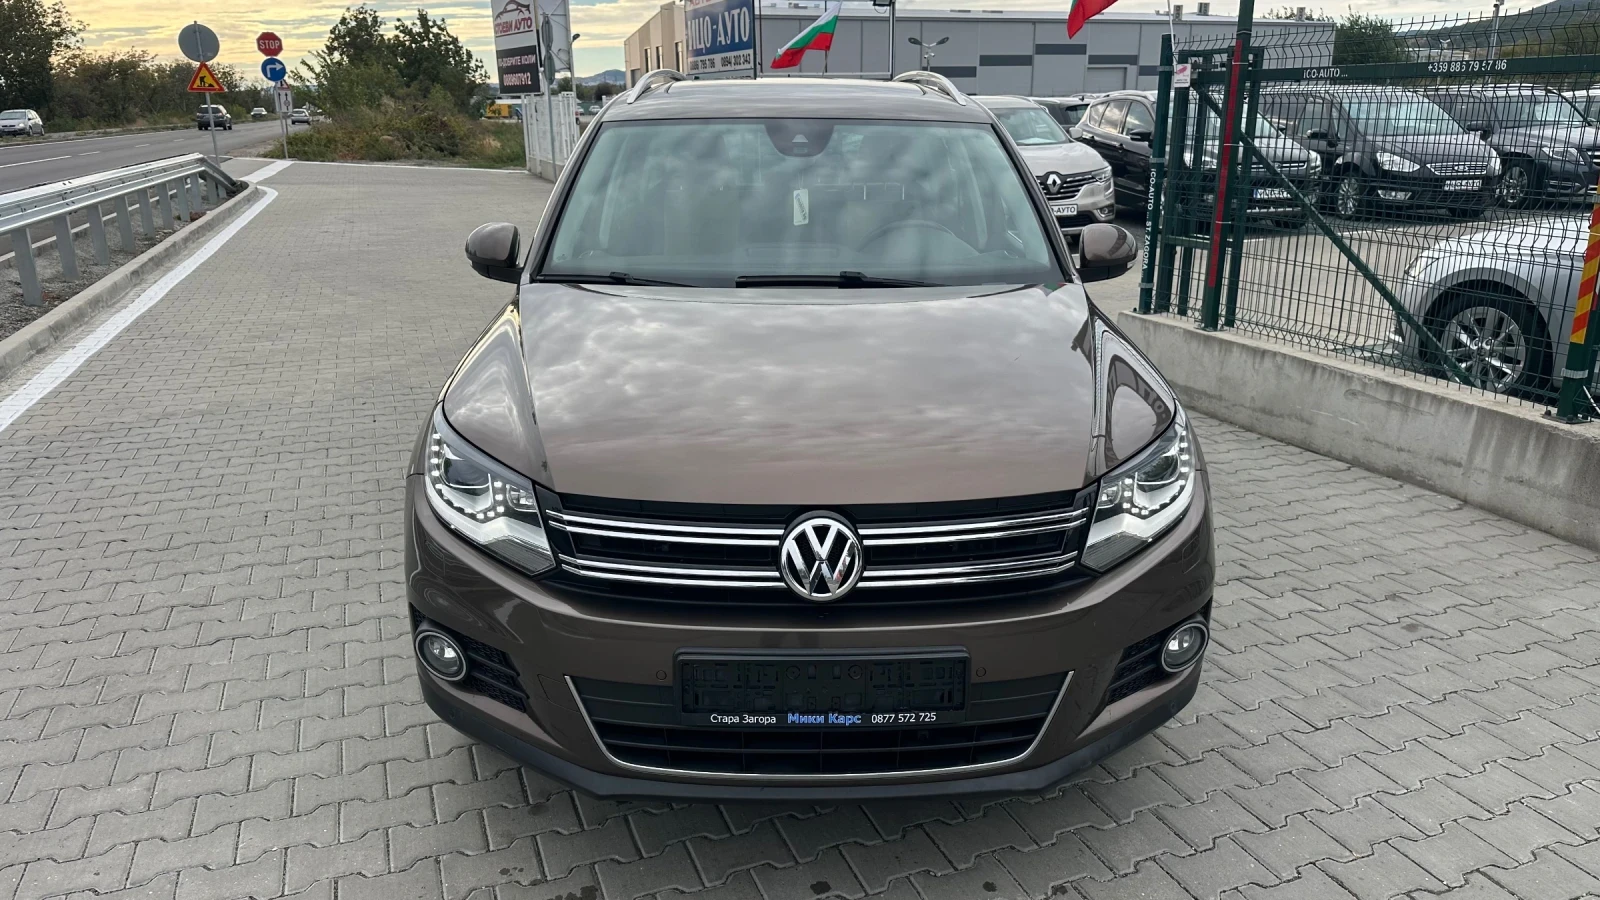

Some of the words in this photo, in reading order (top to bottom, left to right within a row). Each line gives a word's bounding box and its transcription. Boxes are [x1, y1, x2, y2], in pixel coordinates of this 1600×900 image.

[514, 17, 533, 31] АУТО
[259, 40, 280, 49] STOP
[742, 53, 751, 65] 343
[1427, 62, 1448, 74] +359
[1468, 60, 1480, 72] 79
[1142, 234, 1151, 270] ZAGORA
[710, 714, 740, 723] Стара
[742, 714, 777, 725] Загора
[787, 713, 825, 724] Мики
[828, 713, 862, 726] Карс
[871, 714, 895, 723] 0877
[898, 713, 916, 722] 572
[919, 712, 937, 722] 725
